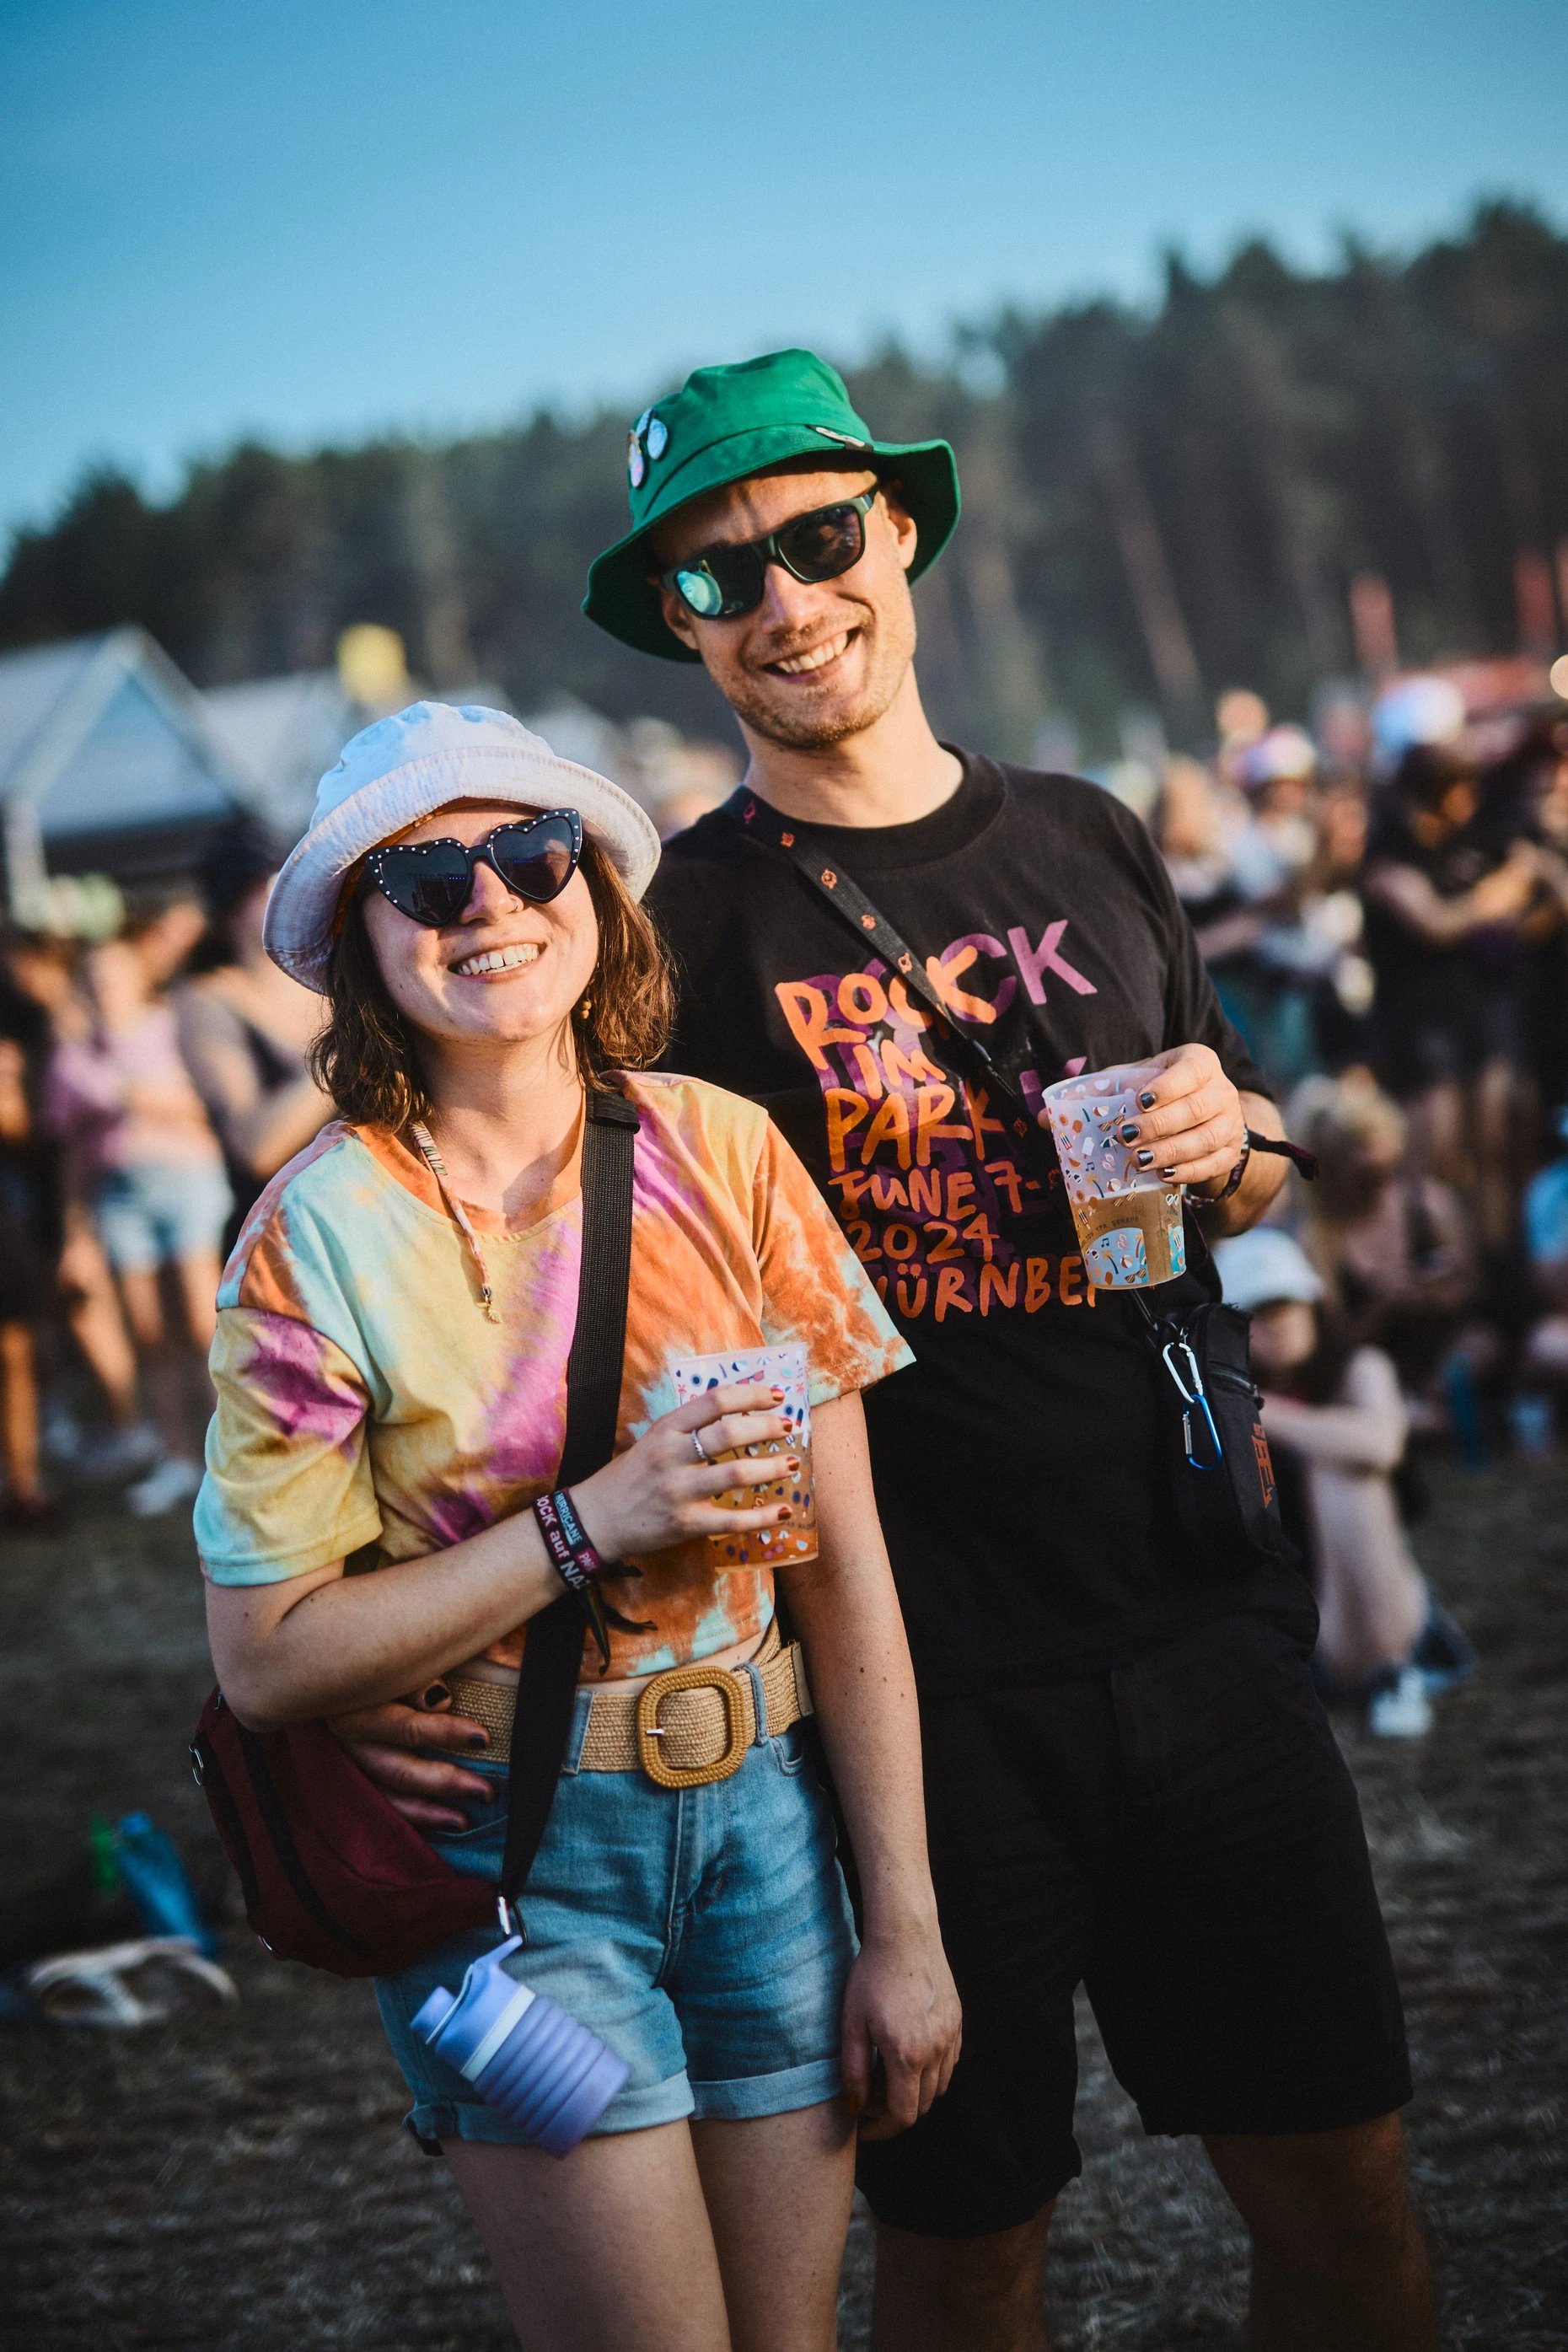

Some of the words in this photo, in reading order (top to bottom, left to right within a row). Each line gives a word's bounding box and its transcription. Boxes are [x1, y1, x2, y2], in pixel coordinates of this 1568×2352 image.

[775, 946, 997, 1070] ROCK
[824, 1082, 1005, 1173] PARK
[846, 1212, 1000, 1265] 2024
[875, 1254, 1097, 1323] ÜRNBE
[550, 1530, 571, 1559] auf
[555, 1492, 583, 1545] HURRICANE
[560, 1560, 591, 1590] NA
